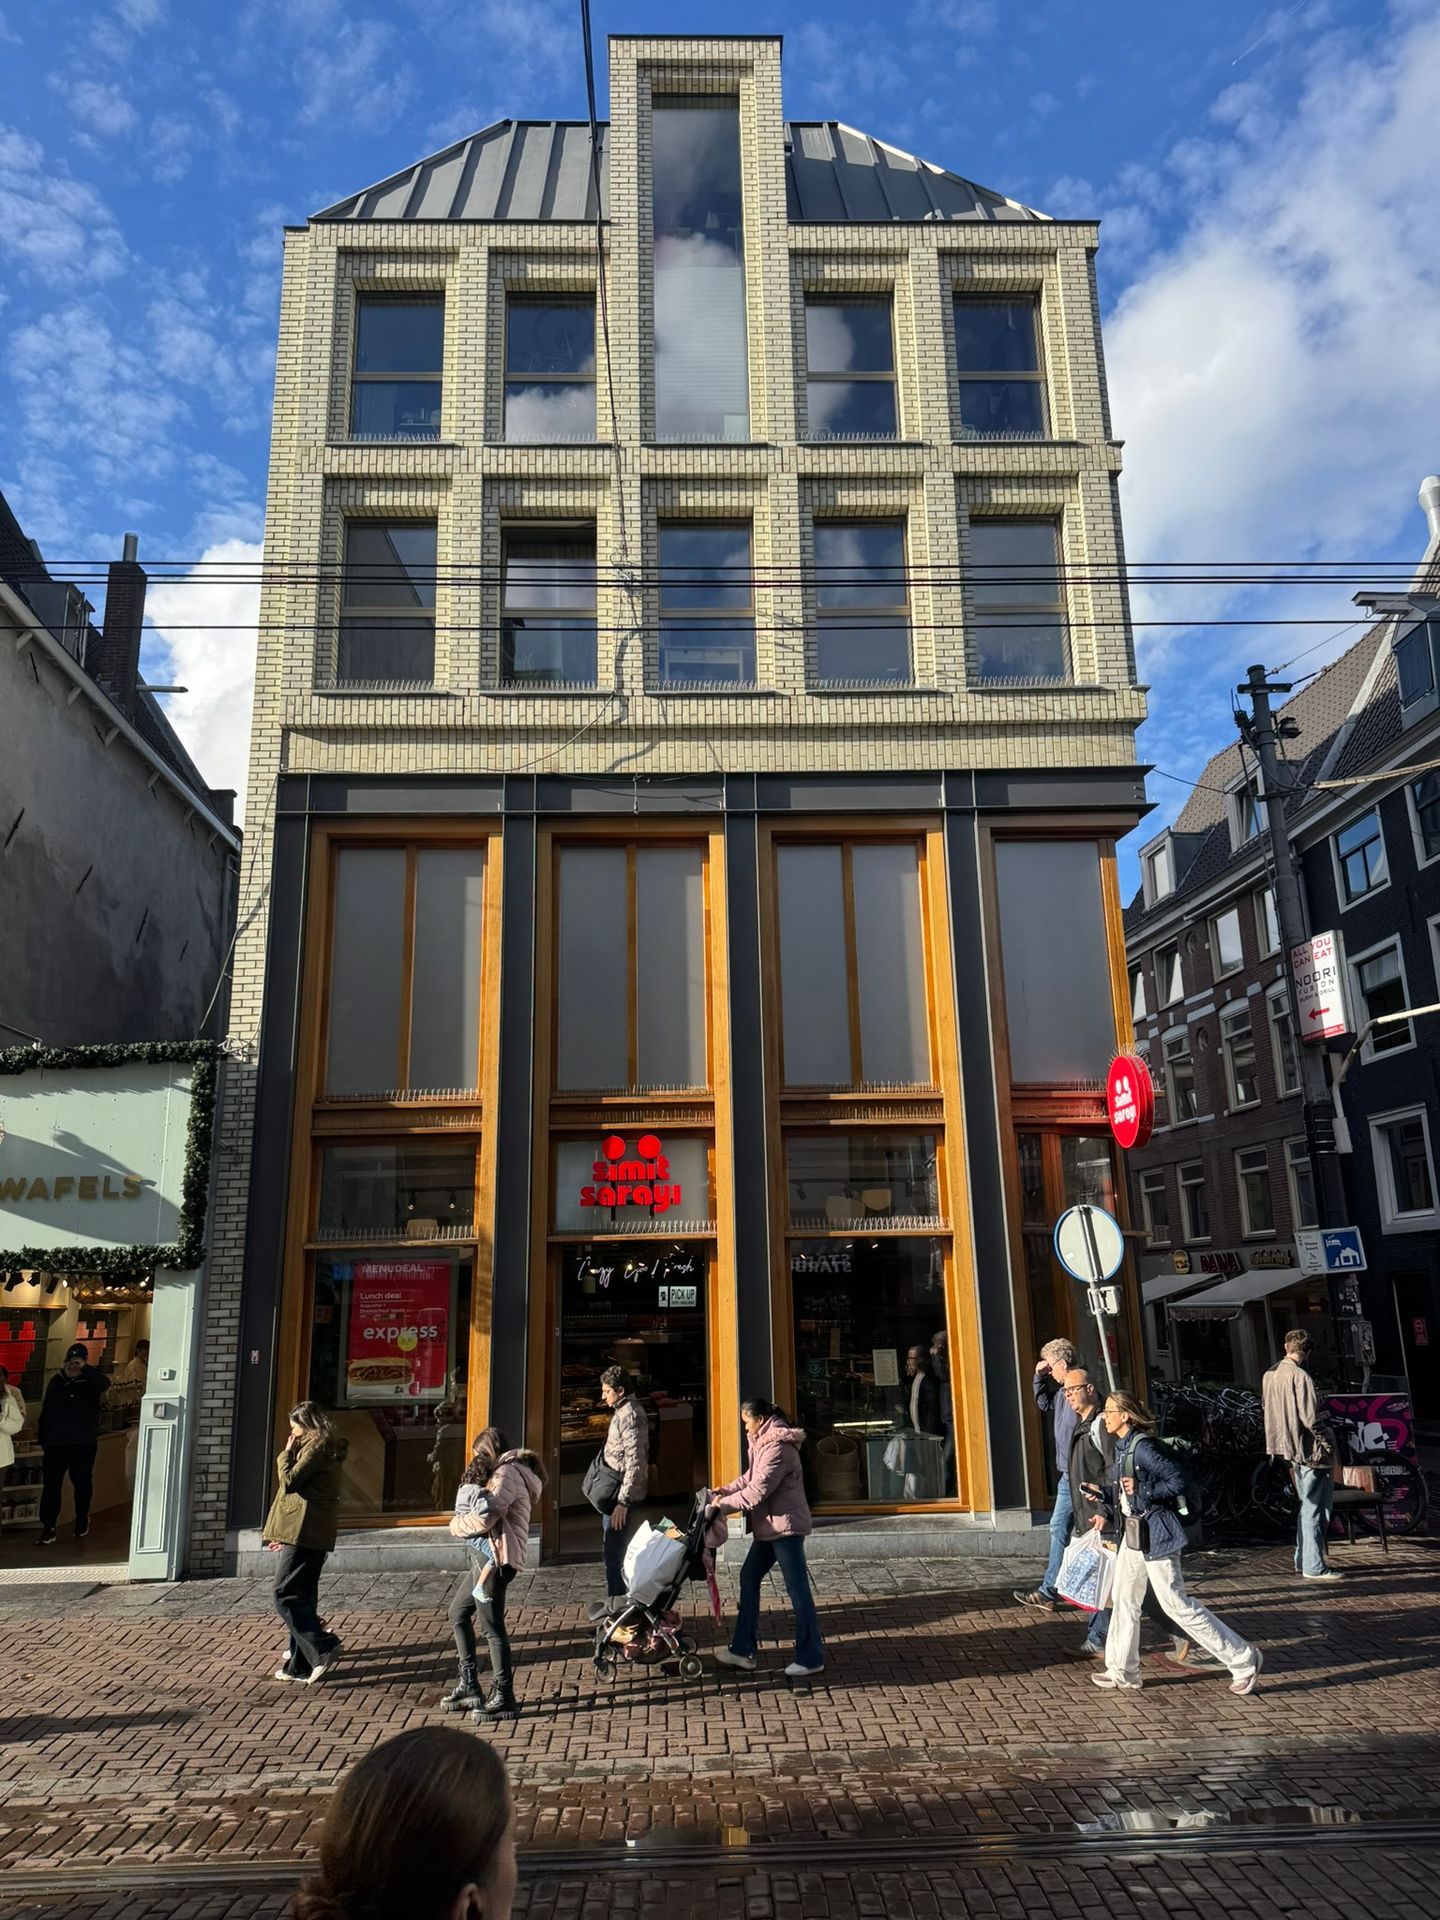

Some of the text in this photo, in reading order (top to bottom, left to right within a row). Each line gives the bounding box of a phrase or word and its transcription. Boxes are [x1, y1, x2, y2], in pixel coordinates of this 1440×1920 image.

[1292, 937, 1331, 959] ALL YOU
[1294, 947, 1333, 969] CAN EAT
[1295, 966, 1336, 988] NOORI
[1299, 979, 1335, 994] FUSION
[592, 1135, 670, 1181] simit
[0, 1174, 143, 1202] WAFELS
[360, 1291, 402, 1300] Lunch deal
[671, 1288, 695, 1300] PICK UP
[363, 1325, 438, 1343] express
